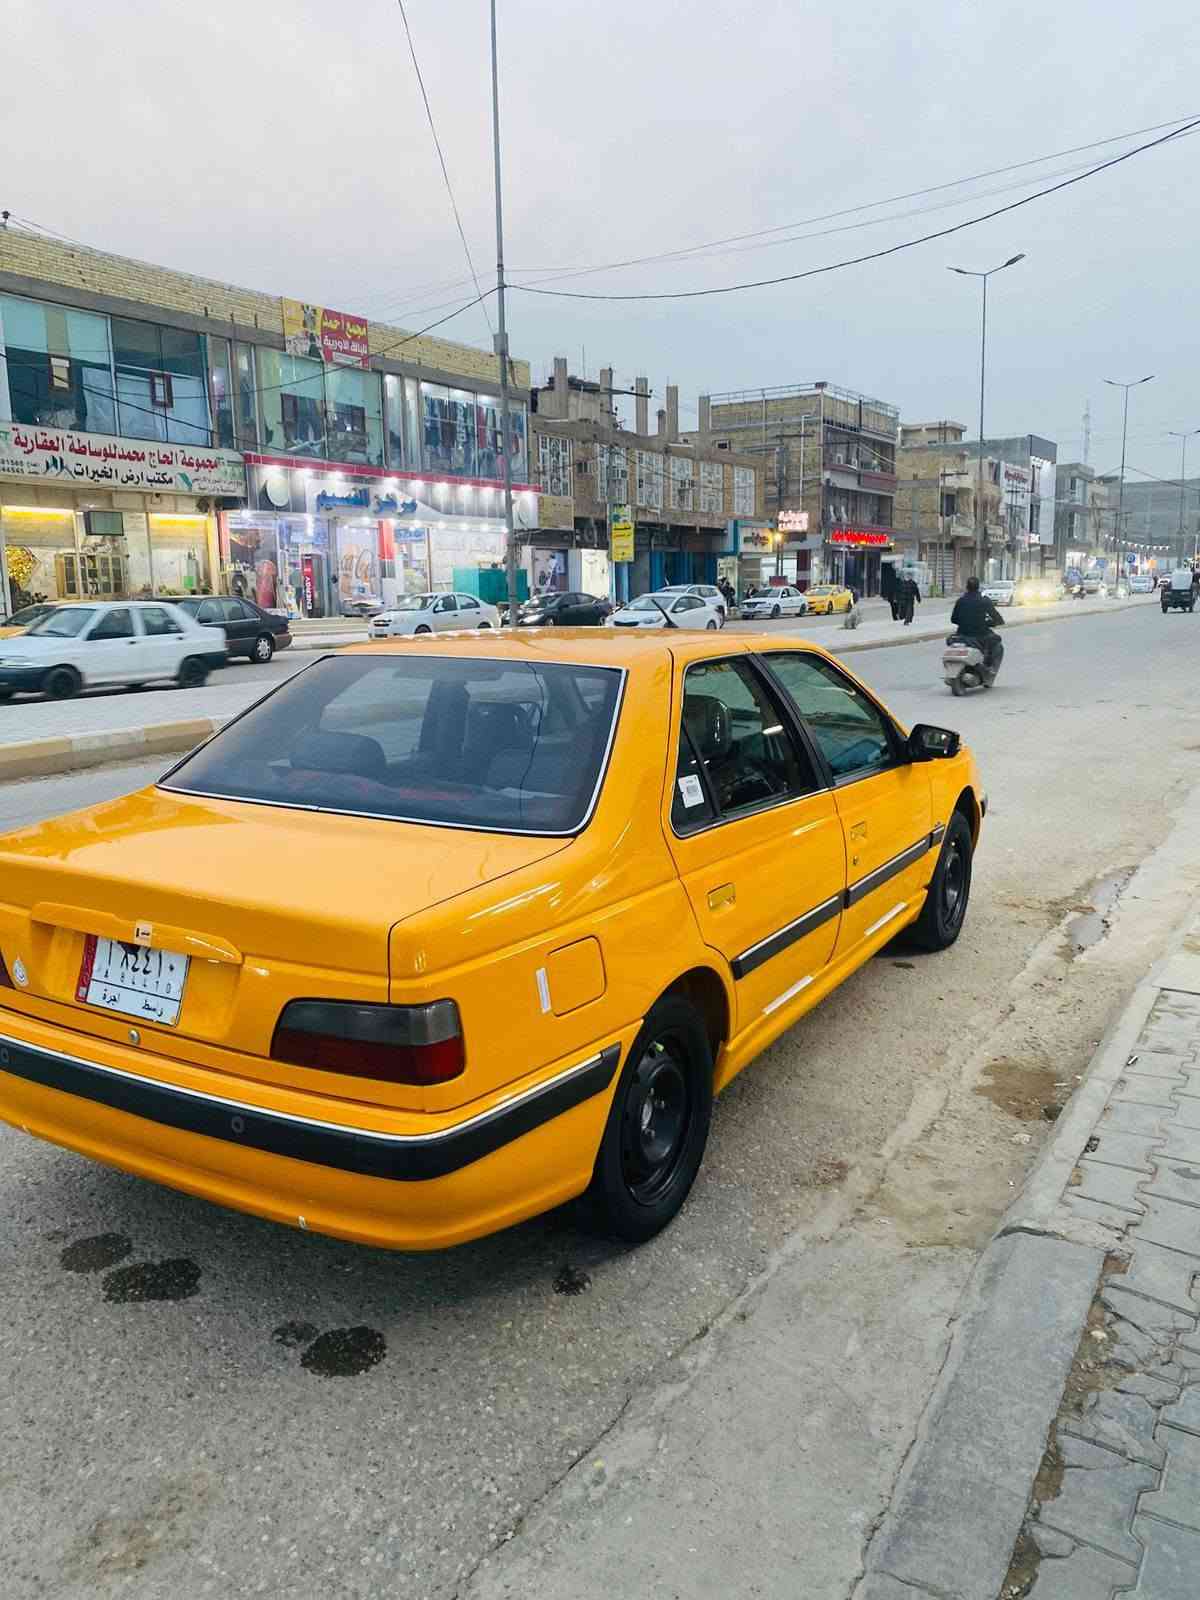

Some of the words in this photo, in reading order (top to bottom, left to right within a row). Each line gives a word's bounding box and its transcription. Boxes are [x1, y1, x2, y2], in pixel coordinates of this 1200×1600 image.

[12, 427, 65, 455] العقارية
[149, 447, 178, 469] الحاج
[179, 449, 218, 473] مجموعة
[74, 463, 119, 483] الخيرات
[120, 469, 144, 484] ارض
[146, 471, 173, 487] مكتب
